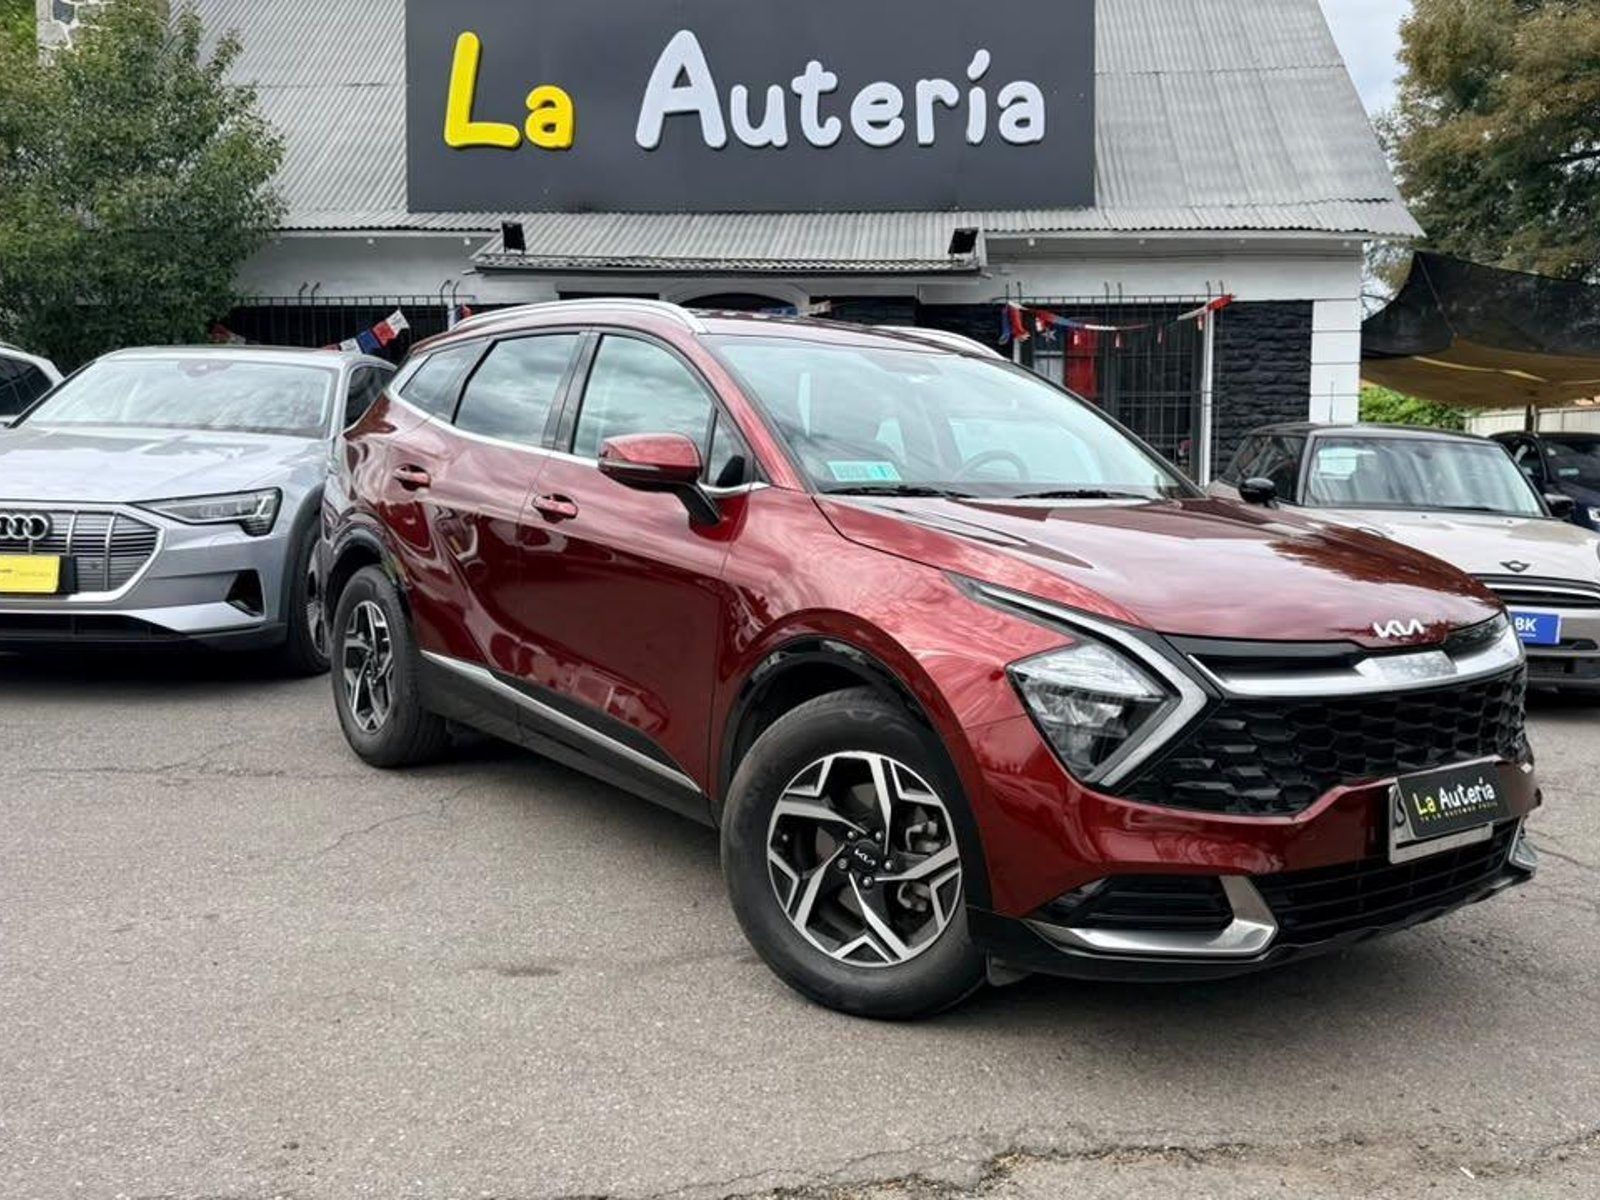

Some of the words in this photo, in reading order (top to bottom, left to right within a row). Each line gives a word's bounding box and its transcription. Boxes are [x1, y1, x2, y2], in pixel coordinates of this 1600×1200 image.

[444, 31, 576, 149] La
[635, 29, 1046, 149] Autería
[1373, 618, 1424, 638] KIA
[1412, 792, 1436, 815] La
